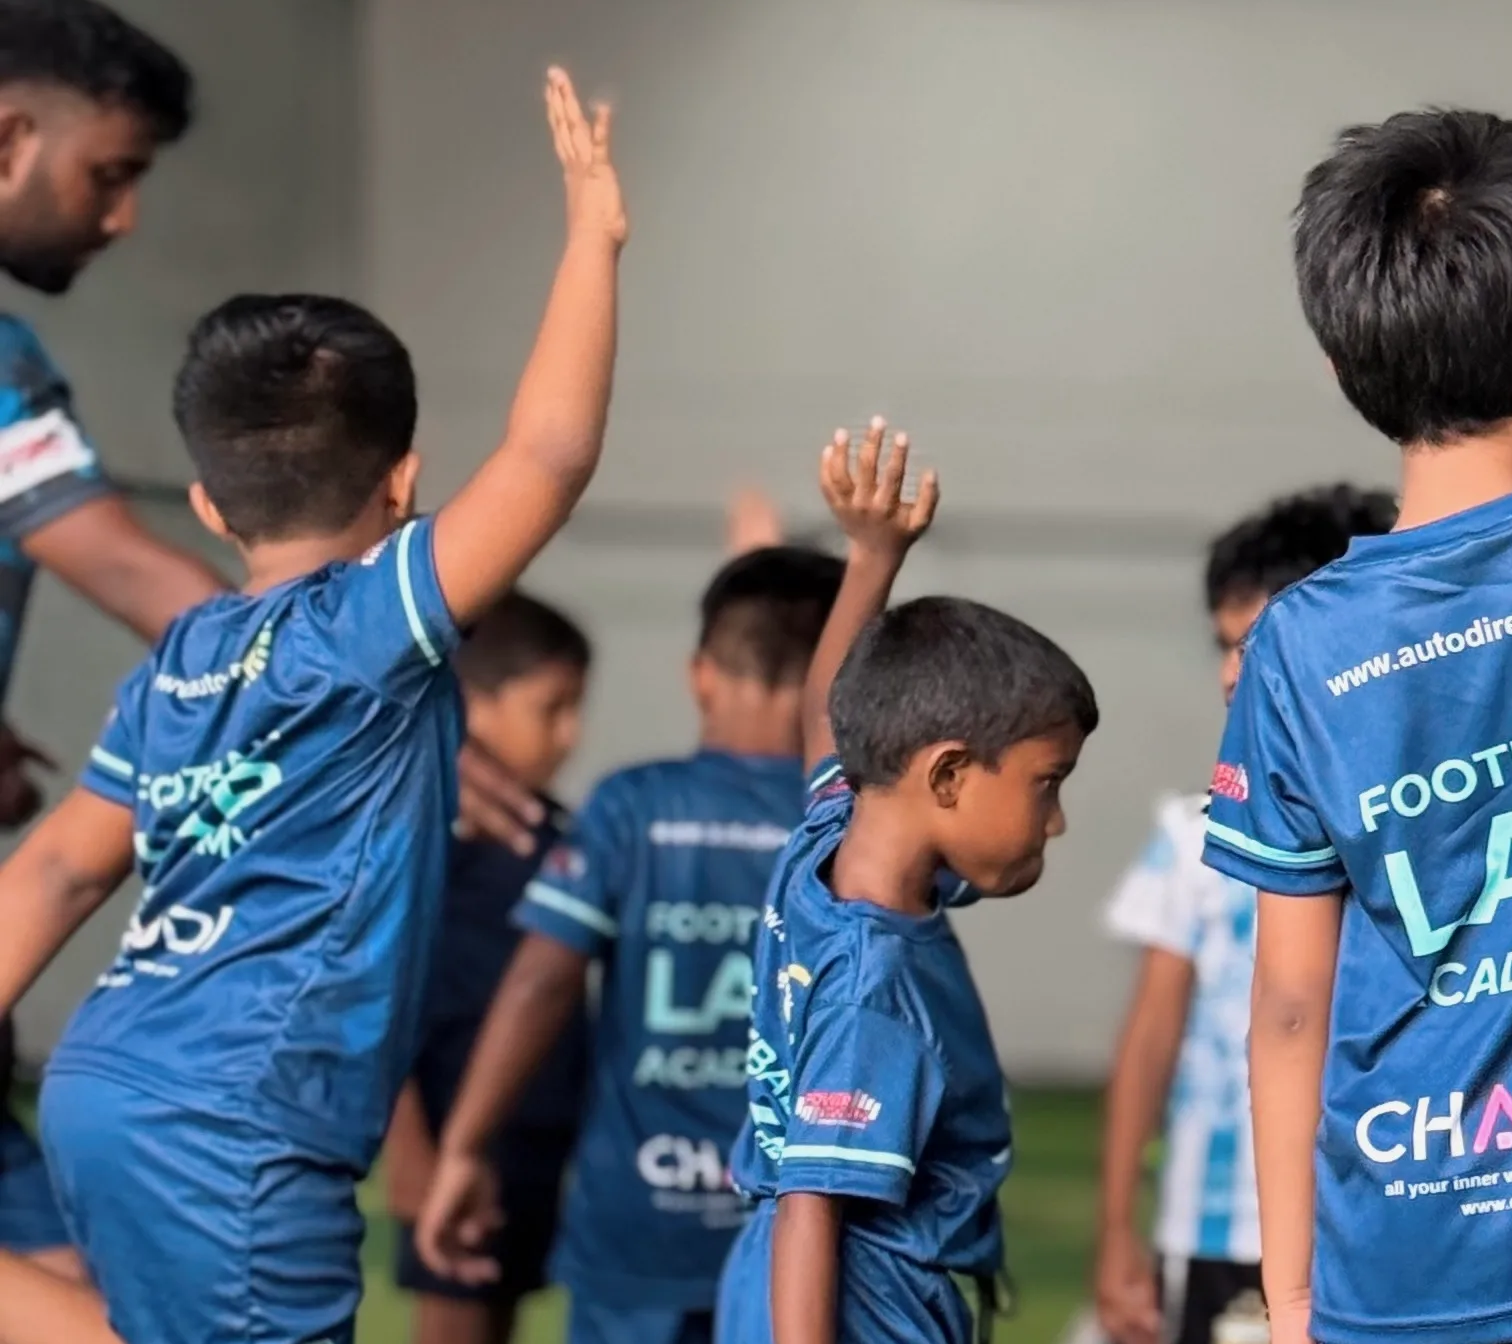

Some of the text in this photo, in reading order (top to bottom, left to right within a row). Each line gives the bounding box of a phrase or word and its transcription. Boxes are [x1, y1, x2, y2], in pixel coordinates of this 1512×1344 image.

[1384, 1180, 1405, 1197] all
[1407, 1179, 1450, 1200] your
[1453, 1171, 1500, 1191] inner
